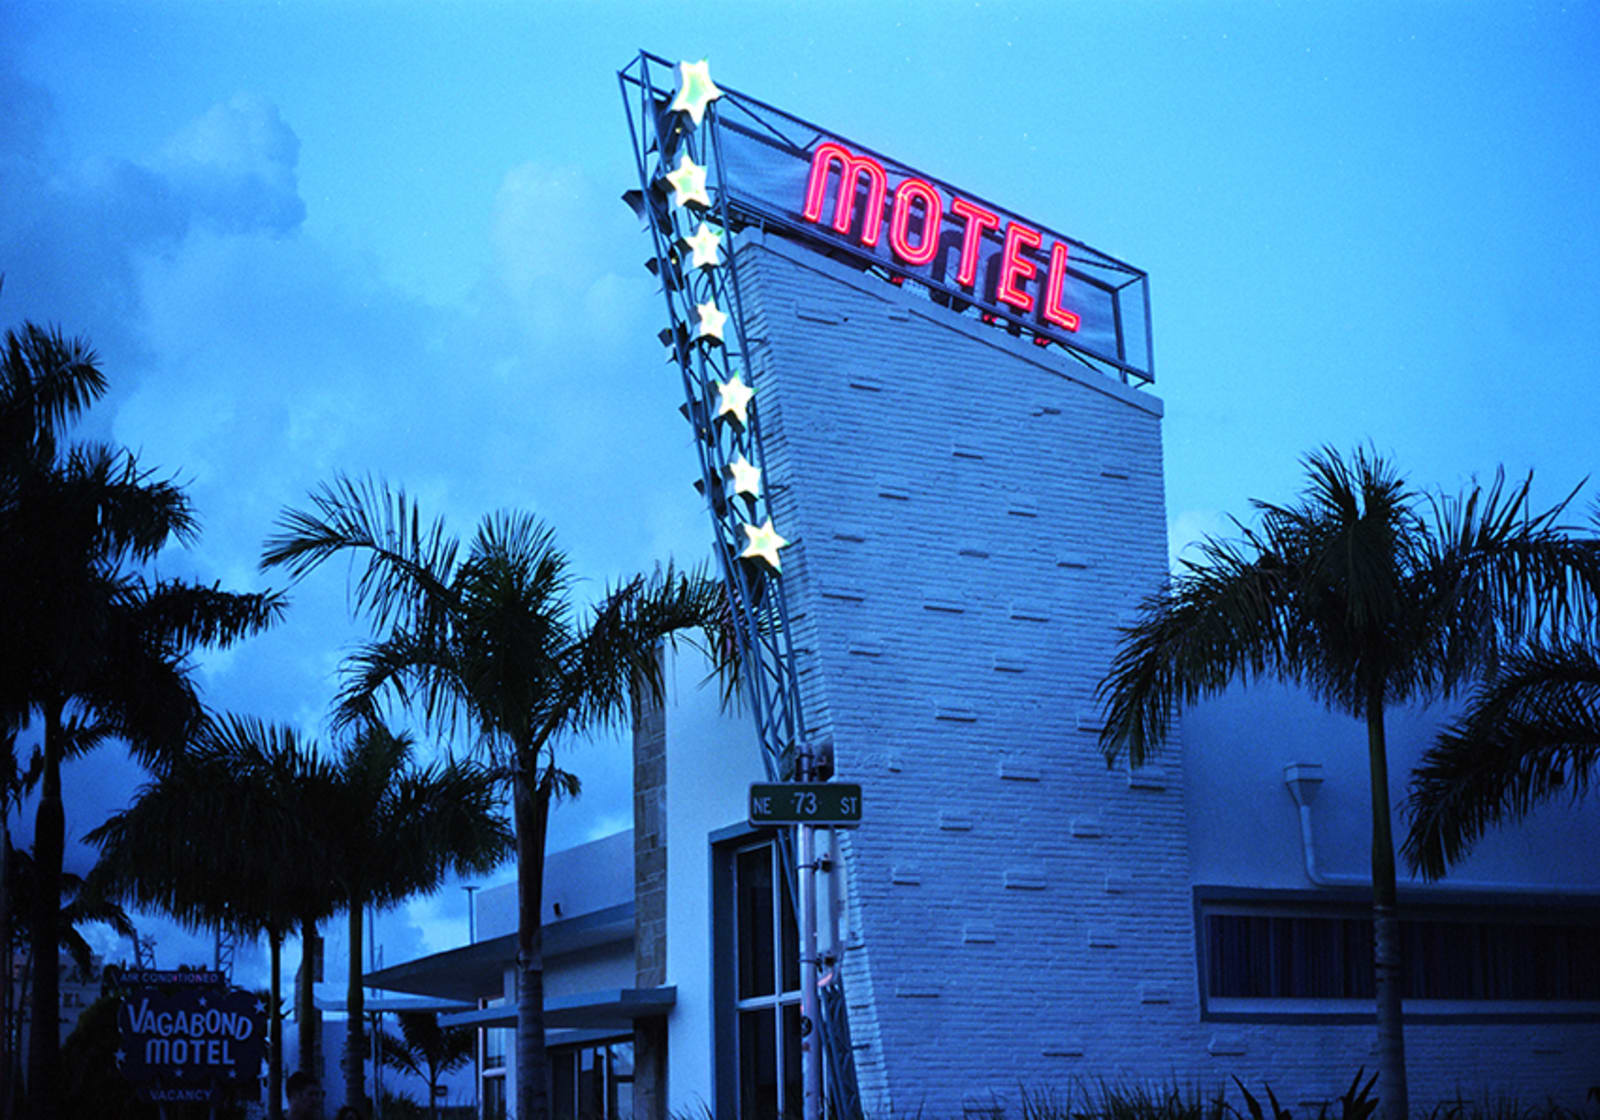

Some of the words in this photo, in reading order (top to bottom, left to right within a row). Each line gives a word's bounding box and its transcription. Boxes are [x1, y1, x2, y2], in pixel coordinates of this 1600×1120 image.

[804, 142, 1080, 332] MOTEL
[753, 797, 772, 815] NE
[794, 792, 816, 814] 73
[840, 796, 857, 815] ST
[127, 998, 253, 1040] VAGABOND
[146, 1039, 235, 1065] MOTEL
[150, 1088, 214, 1101] VACANCY
